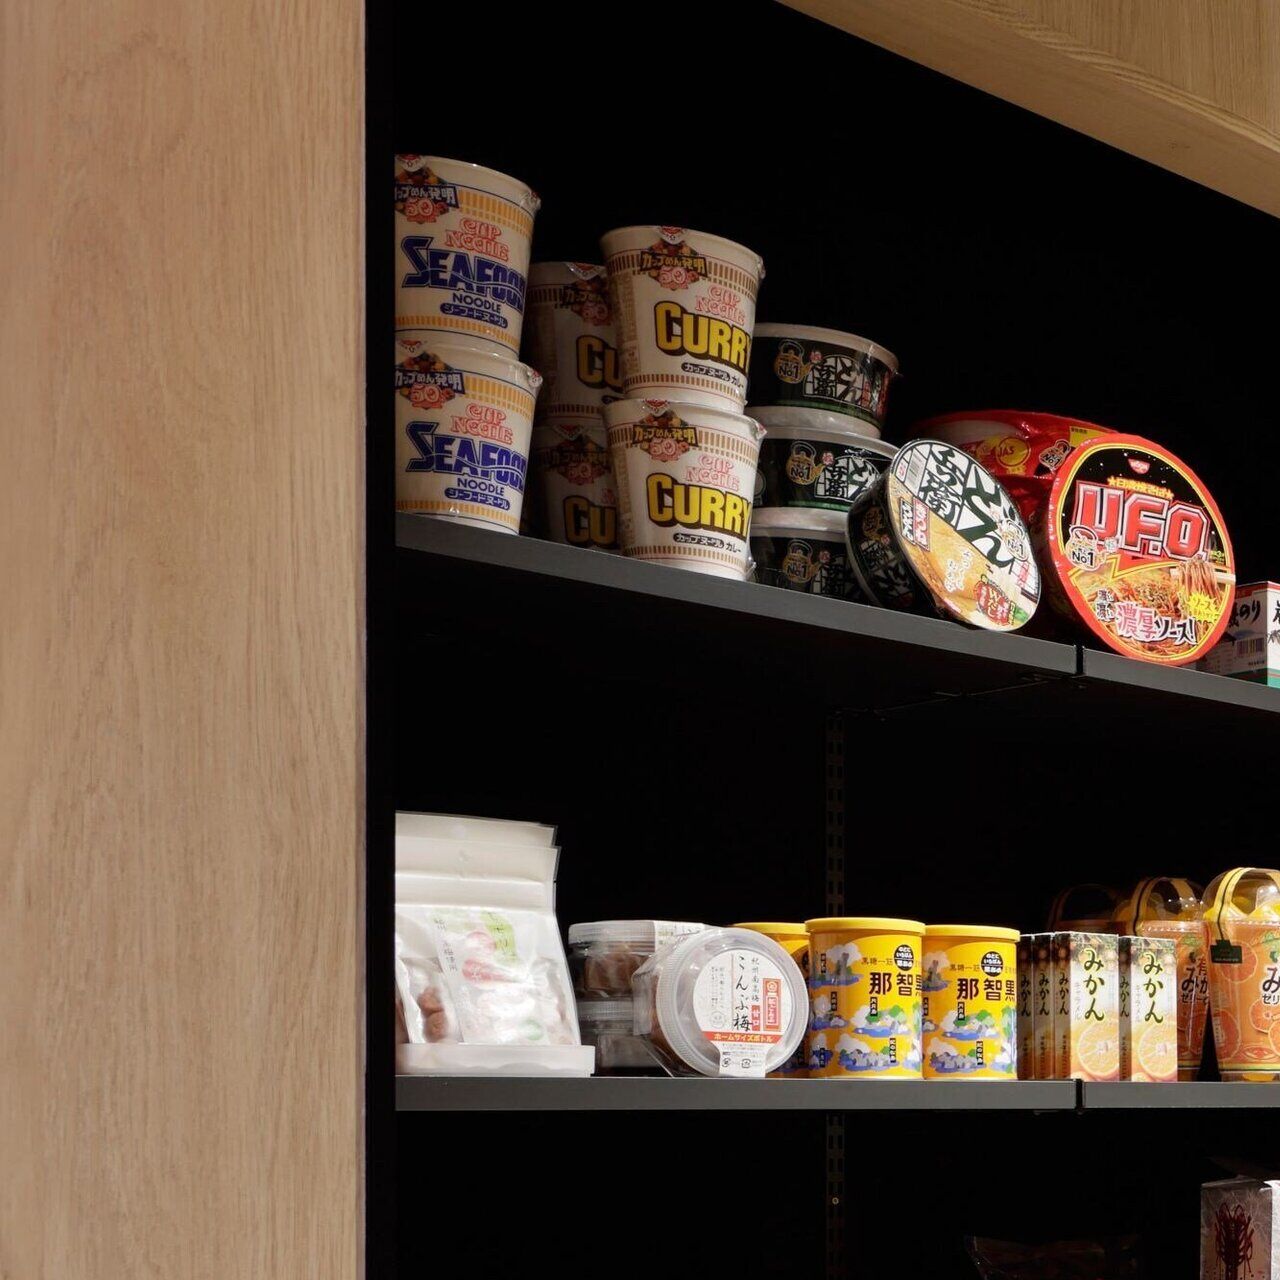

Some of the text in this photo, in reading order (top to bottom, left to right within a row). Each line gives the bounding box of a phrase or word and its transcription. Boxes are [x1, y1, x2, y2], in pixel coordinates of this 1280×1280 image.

[452, 292, 502, 313] NOODLE
[653, 300, 751, 375] CURR
[457, 478, 505, 497] NOODLE
[956, 978, 1016, 1001] 那智黒
[1083, 949, 1105, 1022] みかん
[1143, 952, 1164, 1024] みかん
[713, 1032, 774, 1044] ホームサイズボトル
